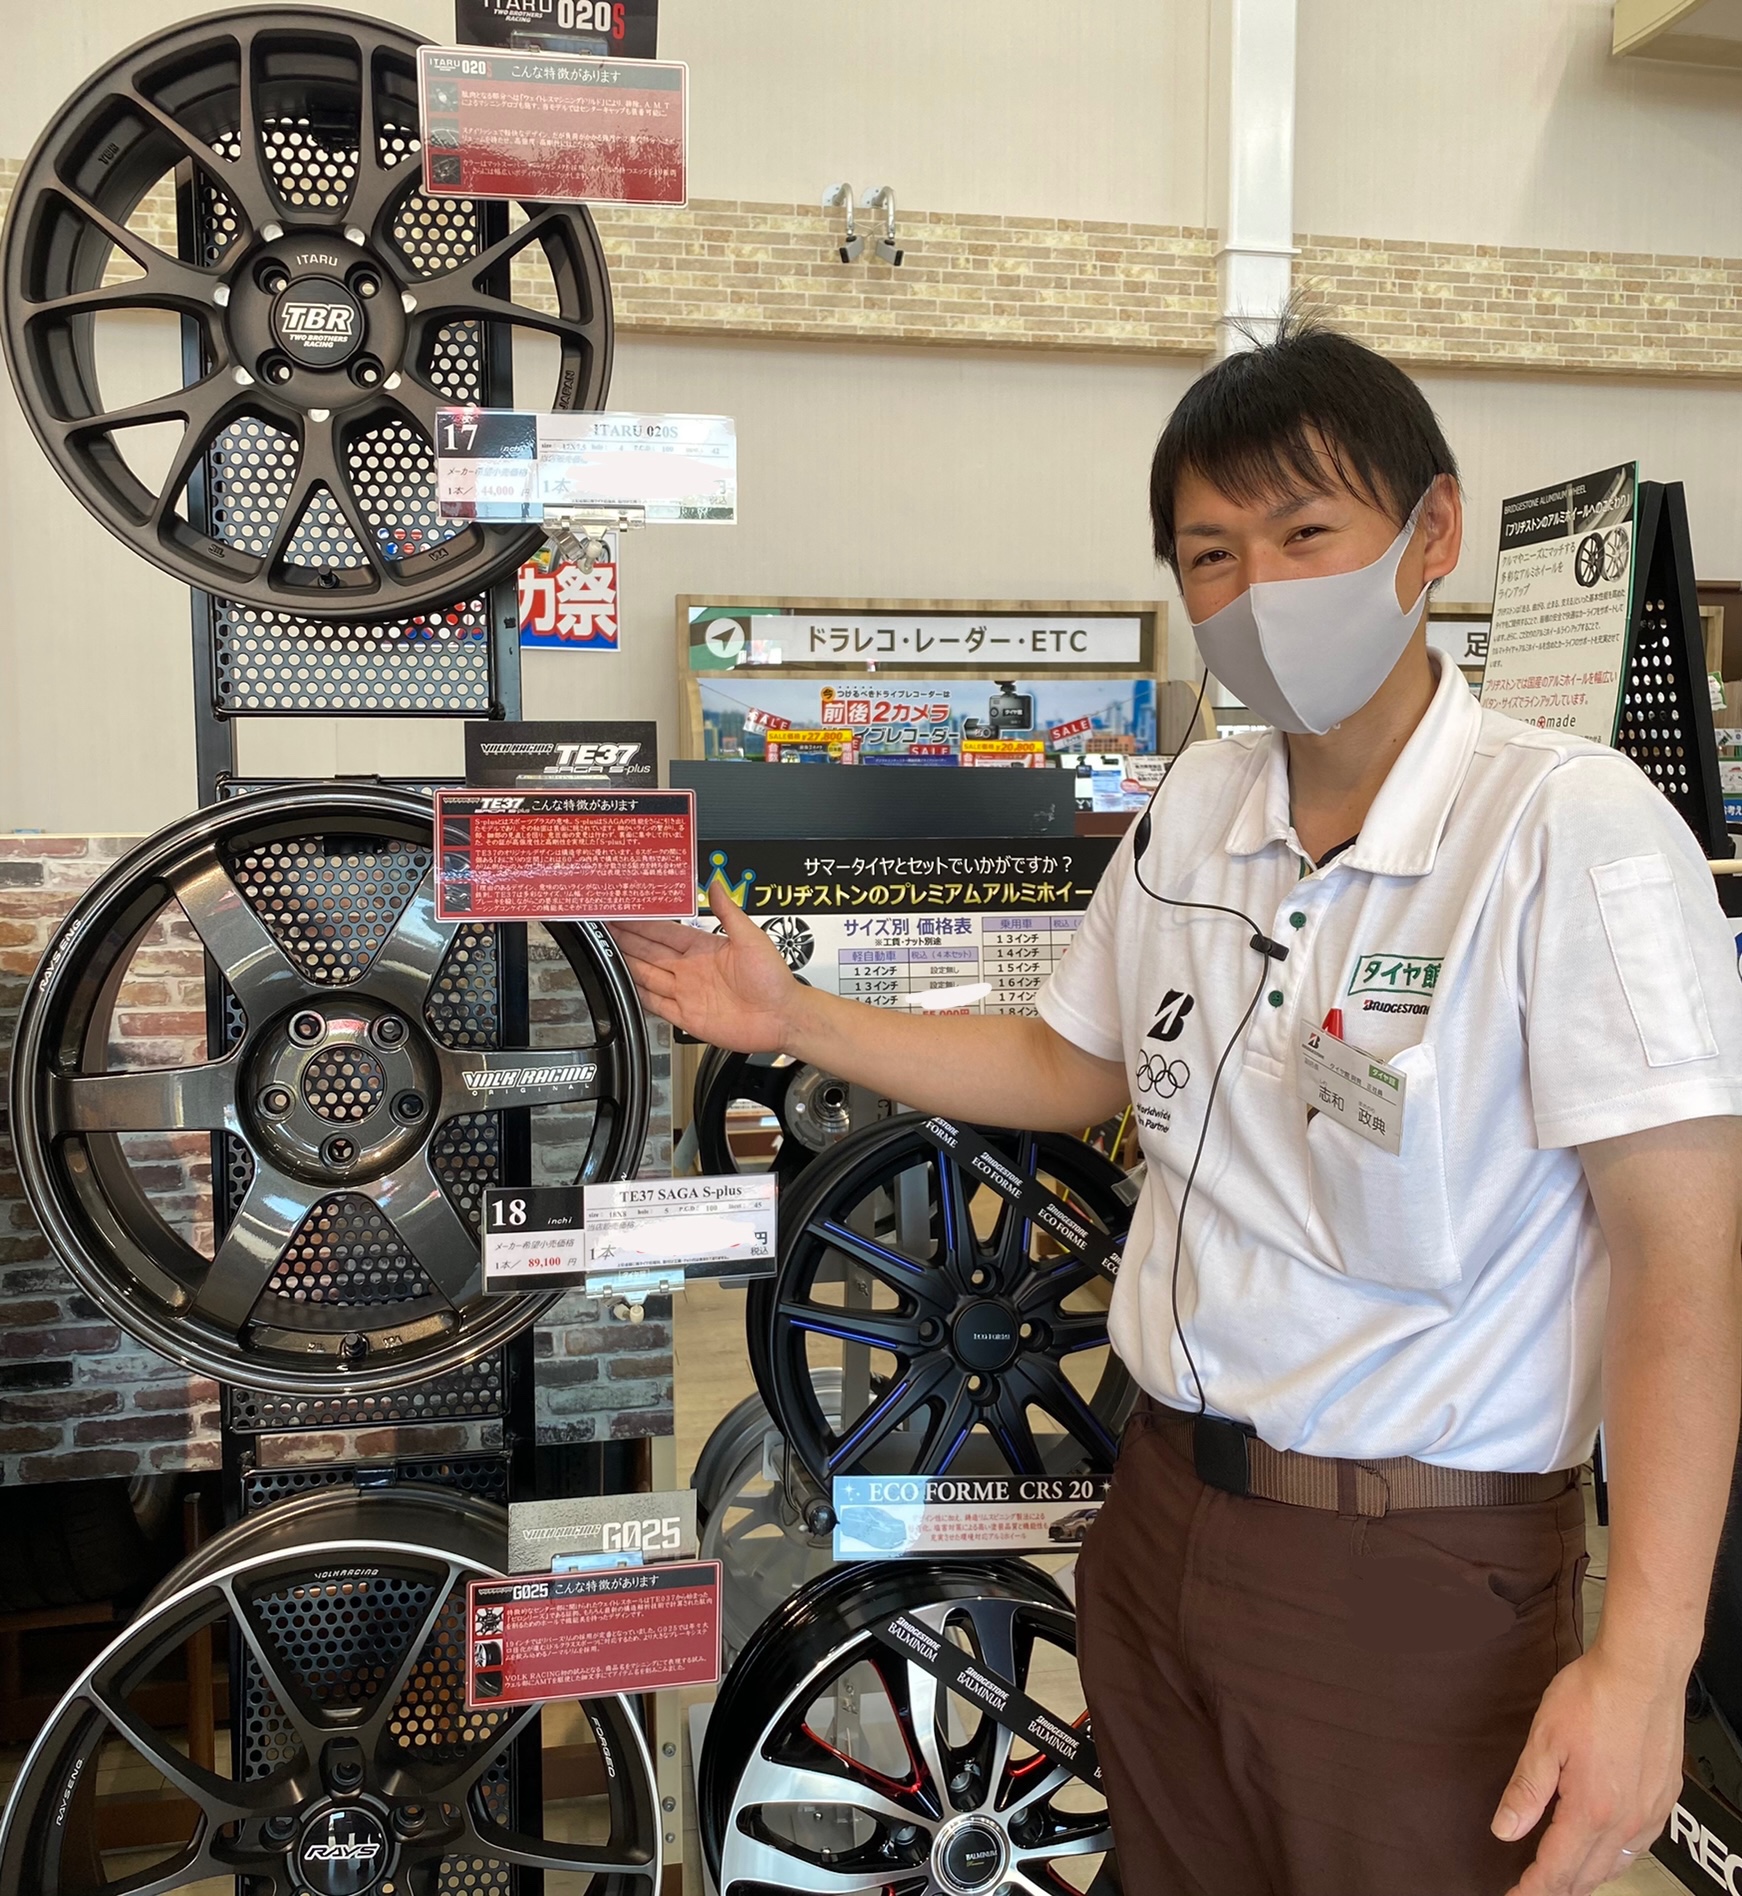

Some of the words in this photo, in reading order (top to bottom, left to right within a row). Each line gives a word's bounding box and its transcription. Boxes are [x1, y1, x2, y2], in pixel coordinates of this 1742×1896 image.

[493, 8, 508, 16] TWO
[509, 10, 543, 19] BROTHERS
[505, 15, 531, 23] RACING
[557, 0, 625, 40] 020S
[430, 58, 460, 67] ITARU
[511, 65, 621, 83] こんな特徴があります
[296, 254, 338, 267] ITARU
[282, 302, 355, 335] TBR
[308, 334, 348, 342] BROTHERS
[558, 370, 576, 411] JAPAN
[443, 423, 478, 451] 17
[593, 424, 643, 438] ITARU
[646, 425, 679, 438] 020S
[1498, 583, 1531, 600] ラインアップ
[808, 625, 1088, 654] ドラレコ・レーダー・ETC
[1052, 721, 1090, 739] SALE
[1547, 714, 1576, 728] made
[554, 742, 642, 767] TE37
[543, 766, 603, 774] SAGA
[608, 764, 652, 775] S-plus
[481, 796, 526, 810] TE37
[532, 798, 639, 812] こんな特徴があります
[803, 856, 1073, 876] サマータイヤとセットでいかがですか？
[755, 881, 1093, 907] ブリヂストンのプレミアムアルミホイー
[844, 917, 910, 937] サイズ別
[917, 917, 972, 936] 価格表
[1000, 918, 1033, 930] 乗用車
[996, 933, 1040, 945] 13インチ
[39, 950, 62, 992] RAYS
[60, 918, 82, 951] ENG
[852, 950, 897, 962] 軽自動車
[997, 948, 1040, 959] 14インチ
[854, 965, 898, 977] 12インチ
[998, 963, 1041, 974] 15インチ
[855, 980, 899, 992] 13インチ
[998, 978, 1042, 989] 16インチ
[462, 1069, 521, 1090] VOLK
[516, 1063, 597, 1087] RACING
[471, 1082, 590, 1097] ORIGINAL
[1319, 1084, 1345, 1112] 志和
[1358, 1107, 1386, 1136] 政典
[971, 1156, 993, 1176] ECO
[989, 1171, 1023, 1199] FORME
[980, 1150, 1024, 1187] BRIDGESTONE
[619, 1189, 654, 1203] TE37
[658, 1187, 699, 1201] SAGA
[702, 1185, 742, 1199] S-plus
[491, 1198, 527, 1227] 18
[547, 1216, 573, 1225] inchi
[1047, 1203, 1090, 1238] BRIDGESTONE
[1037, 1207, 1058, 1228] ECO
[1055, 1222, 1088, 1250] FORME
[494, 1238, 575, 1251] メーカー希望小売価格
[590, 1244, 617, 1261] 1本
[528, 1256, 561, 1268] 89,100
[567, 1257, 577, 1266] 円
[868, 1482, 919, 1501] ECO
[925, 1481, 1010, 1501] FORME
[1019, 1481, 1063, 1500] CRS
[1068, 1480, 1094, 1499] 20
[602, 1516, 681, 1554] G025
[513, 1582, 549, 1601] G025
[554, 1574, 660, 1595] こんな特徴があります
[887, 1621, 939, 1662] BALMINUM
[896, 1616, 941, 1651] BRIDGESTONE
[956, 1671, 1007, 1712] BALMINUM
[965, 1666, 1009, 1700] BRIDGESTONE
[1027, 1720, 1077, 1761] BALMINUM
[1035, 1715, 1080, 1749] BRIDGESTONE
[591, 1716, 616, 1777] FORGED
[304, 1843, 380, 1860] RAYS
